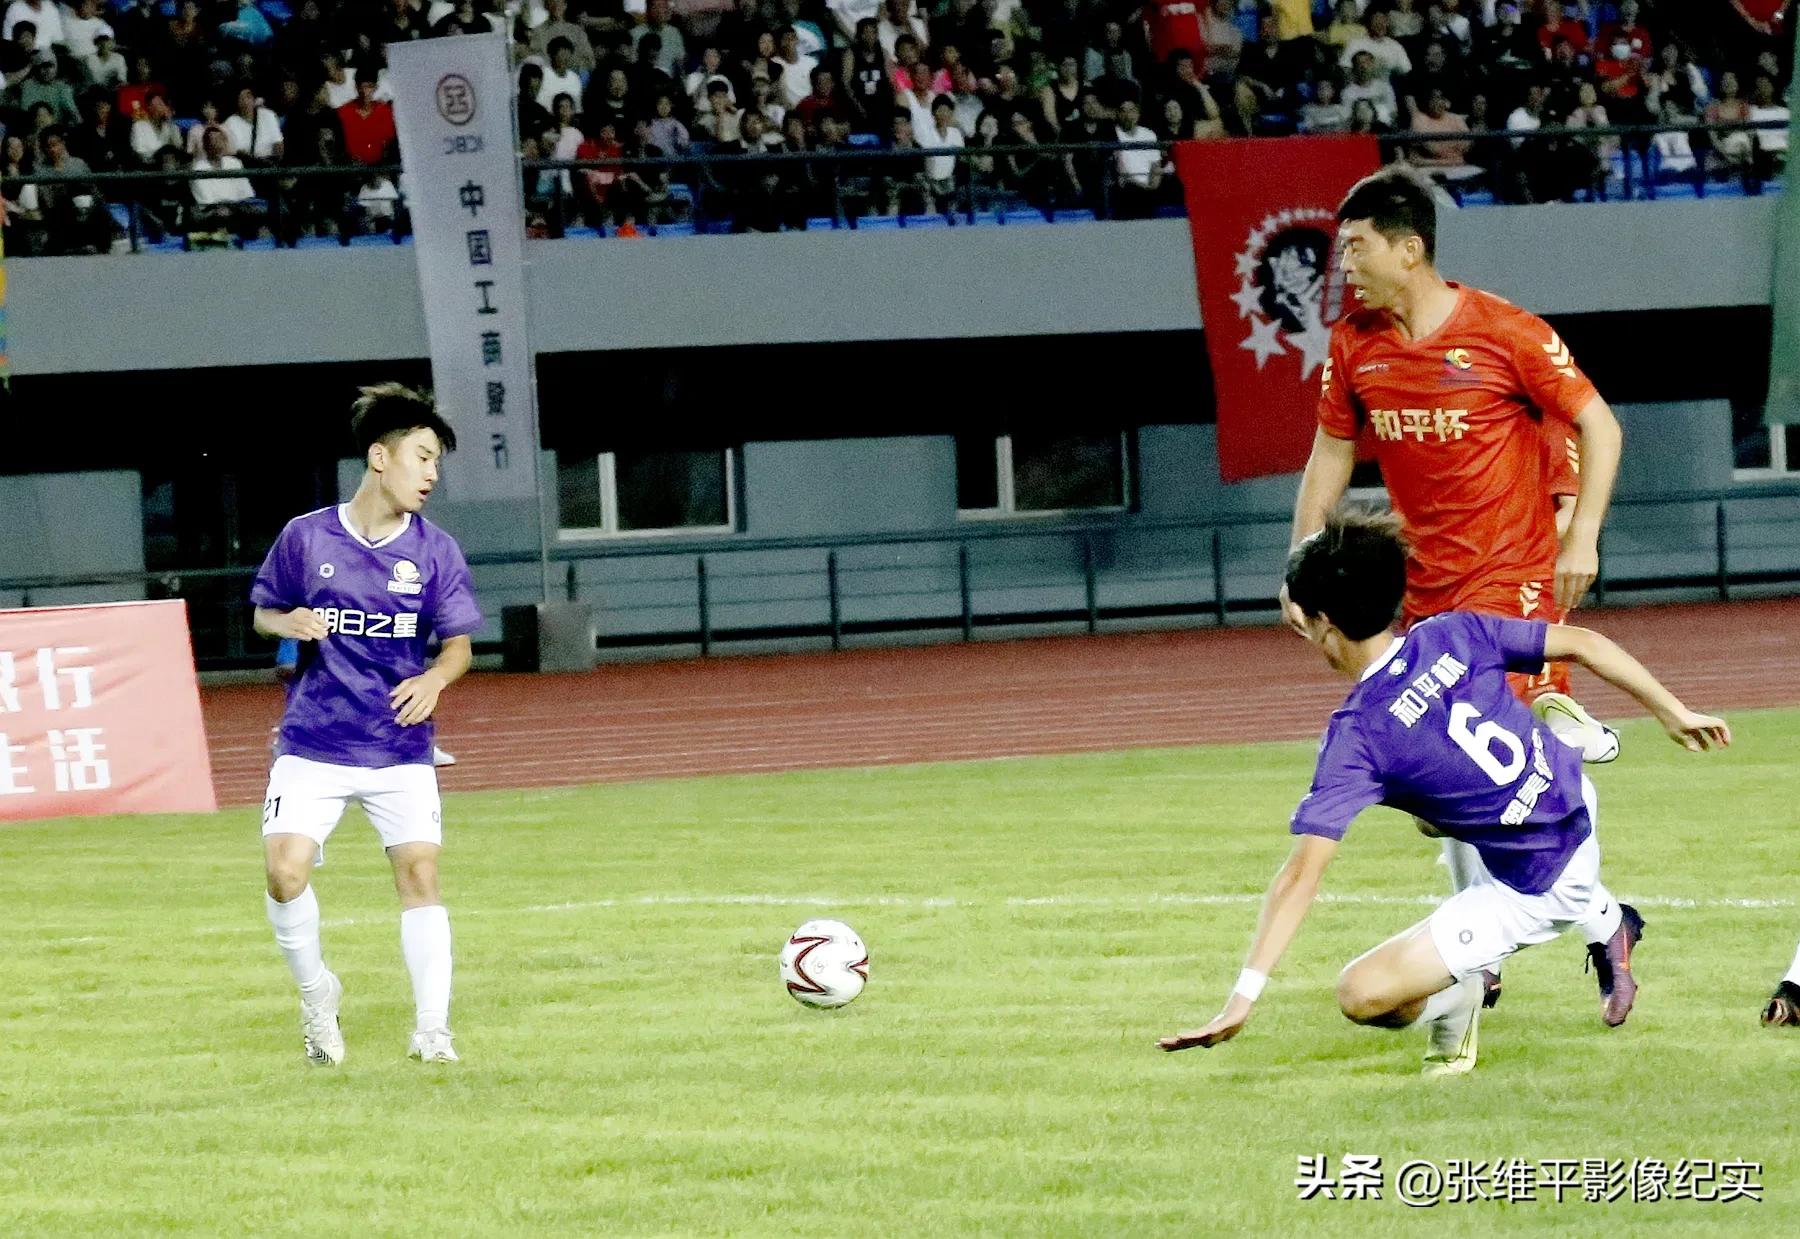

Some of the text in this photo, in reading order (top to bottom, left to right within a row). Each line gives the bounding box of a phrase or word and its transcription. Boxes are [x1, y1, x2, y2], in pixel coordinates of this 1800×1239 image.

[1370, 408, 1471, 442] 和平杯
[312, 607, 418, 638] 明日之星
[1389, 652, 1469, 728] 和平杯
[0, 727, 112, 794] 生活
[1447, 702, 1527, 786] 6
